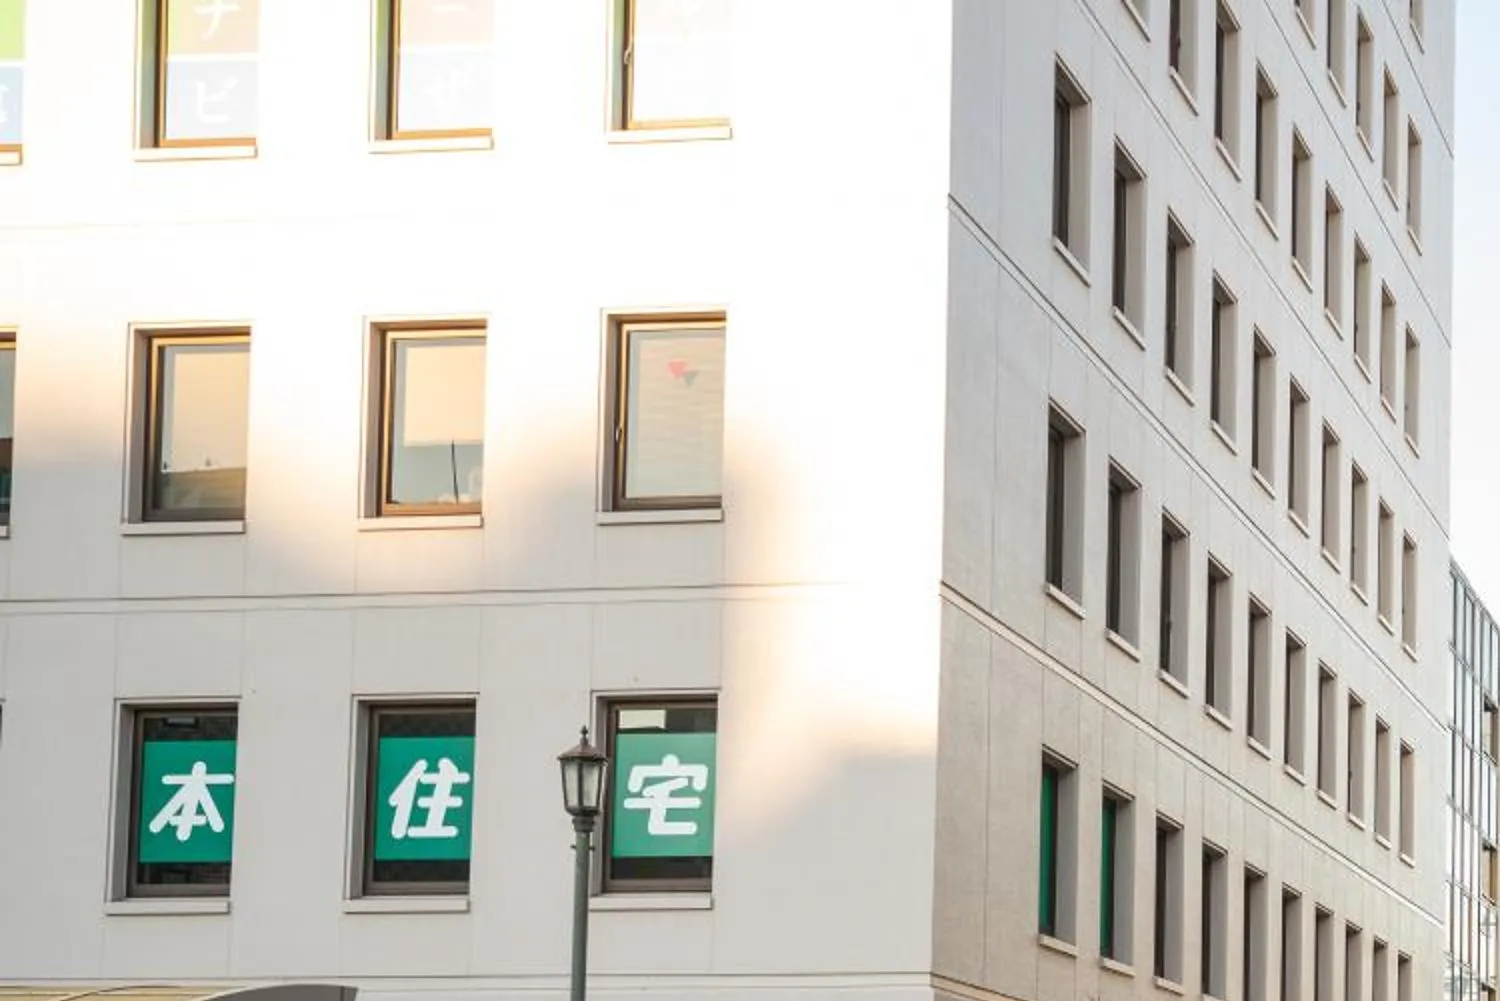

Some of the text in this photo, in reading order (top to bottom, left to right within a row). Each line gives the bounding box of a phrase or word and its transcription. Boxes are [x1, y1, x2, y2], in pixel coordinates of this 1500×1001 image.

[149, 753, 709, 841] 本 住 宅
